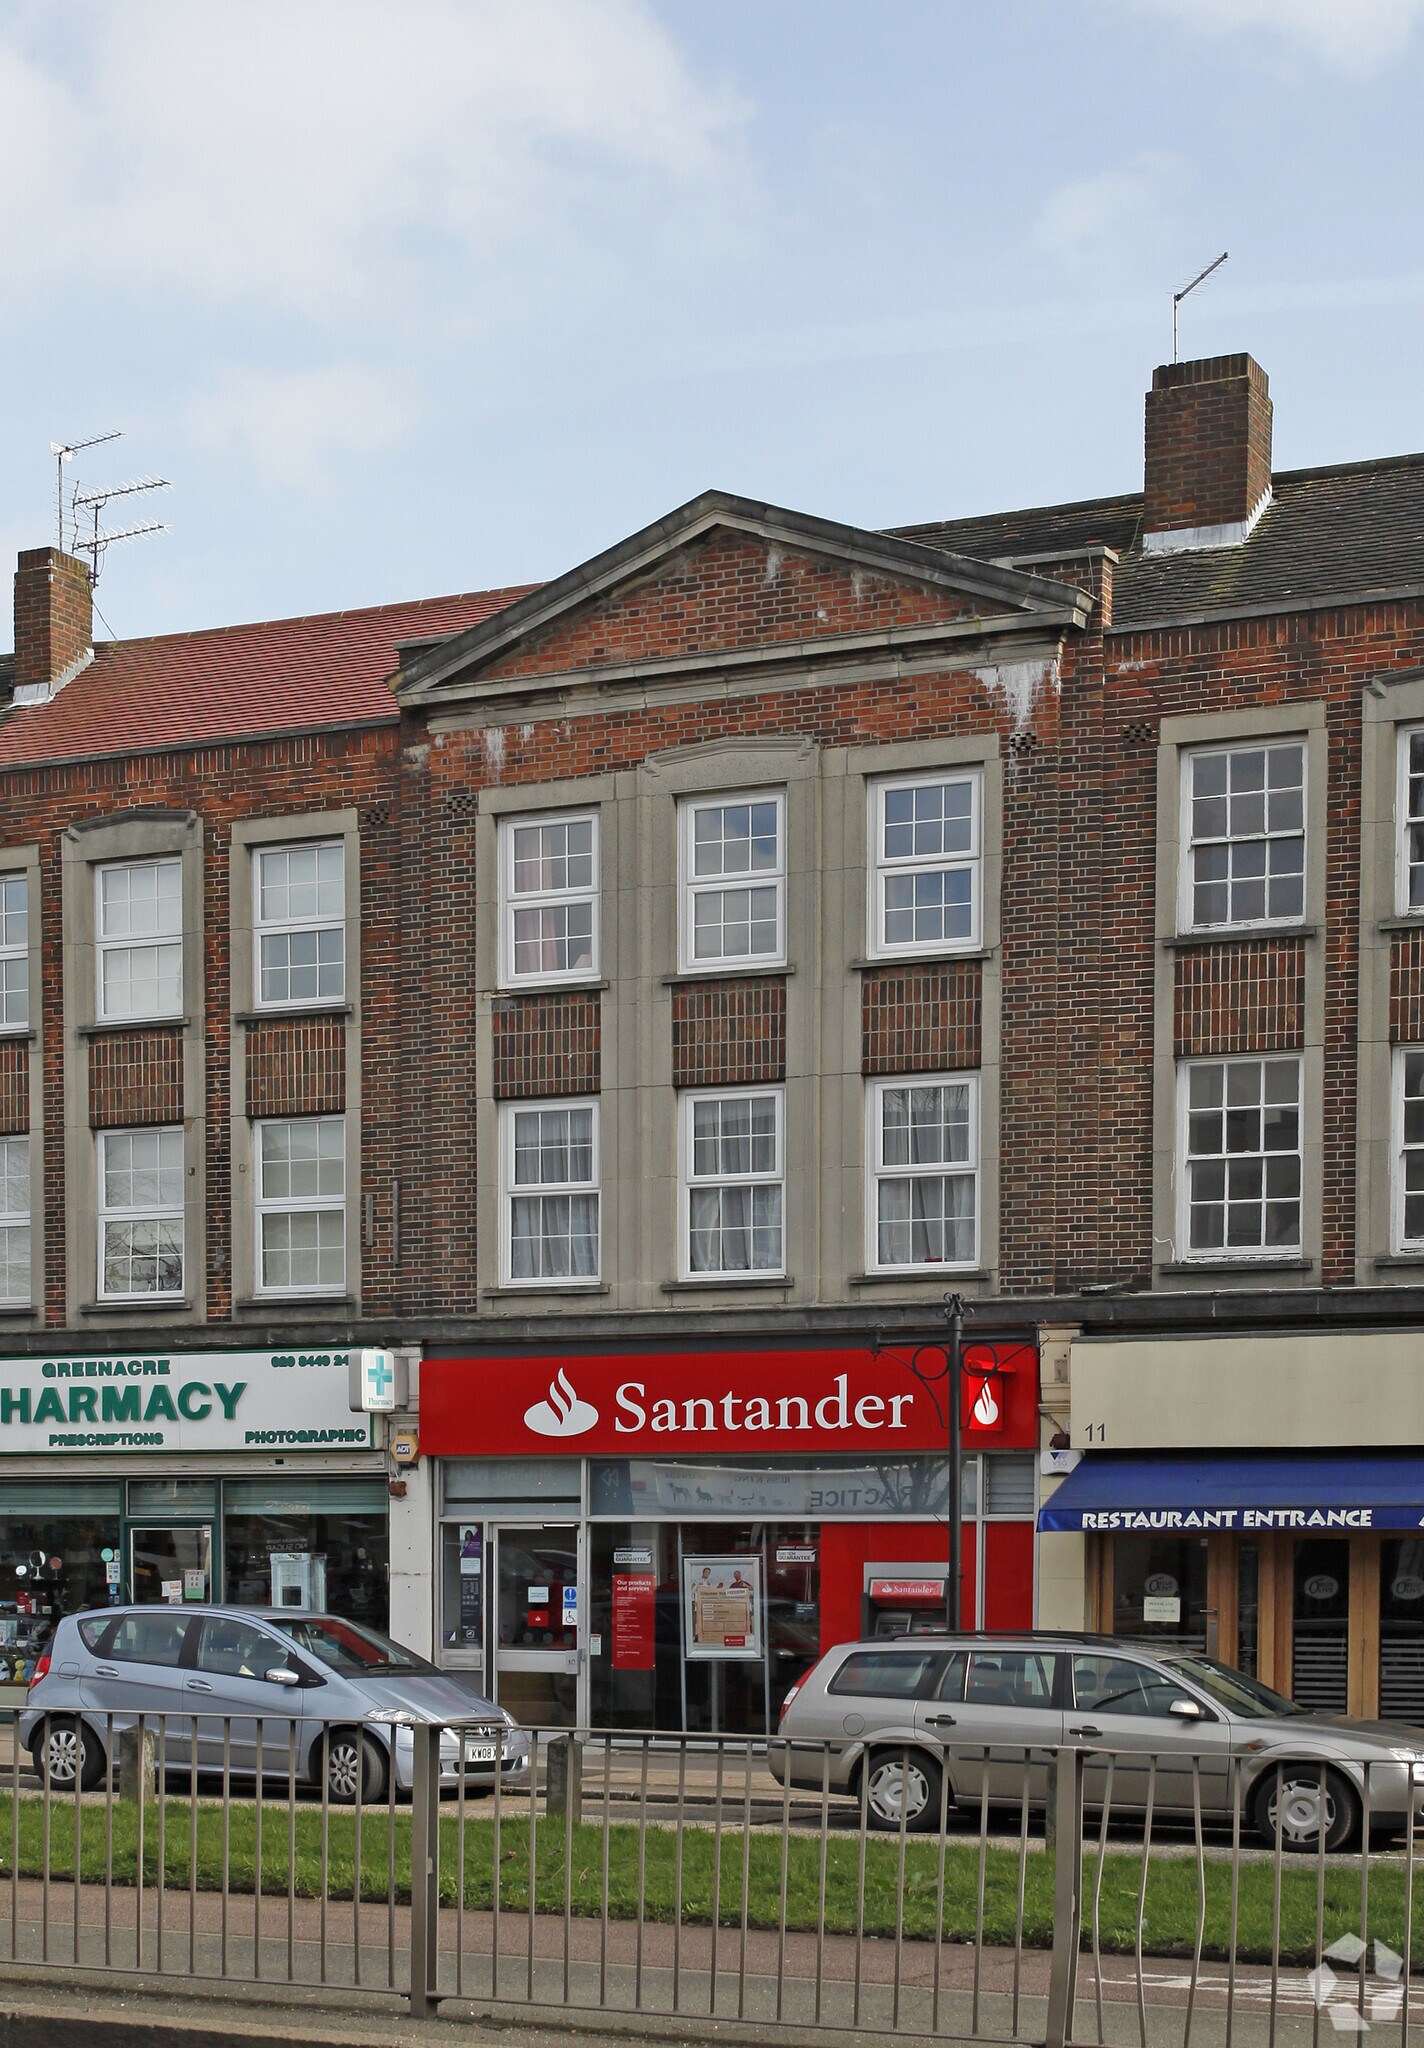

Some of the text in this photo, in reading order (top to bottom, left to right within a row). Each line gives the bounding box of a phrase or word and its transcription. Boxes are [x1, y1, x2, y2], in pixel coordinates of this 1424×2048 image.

[42, 1360, 171, 1378] GREENACRE
[271, 1355, 295, 1368] 020
[334, 1354, 349, 1367] 24
[0, 1381, 248, 1424] HARMACY
[613, 1373, 914, 1434] Santander
[49, 1432, 164, 1447] PRESCRIPTIONS
[244, 1428, 366, 1444] PHOTOGRAPHIC
[1085, 1423, 1105, 1442] 11
[396, 1445, 410, 1454] ADT
[1082, 1509, 1373, 1529] RESTAURANT ENTRANCE
[893, 1585, 933, 1593] Santander
[472, 1748, 492, 1759] KW08
